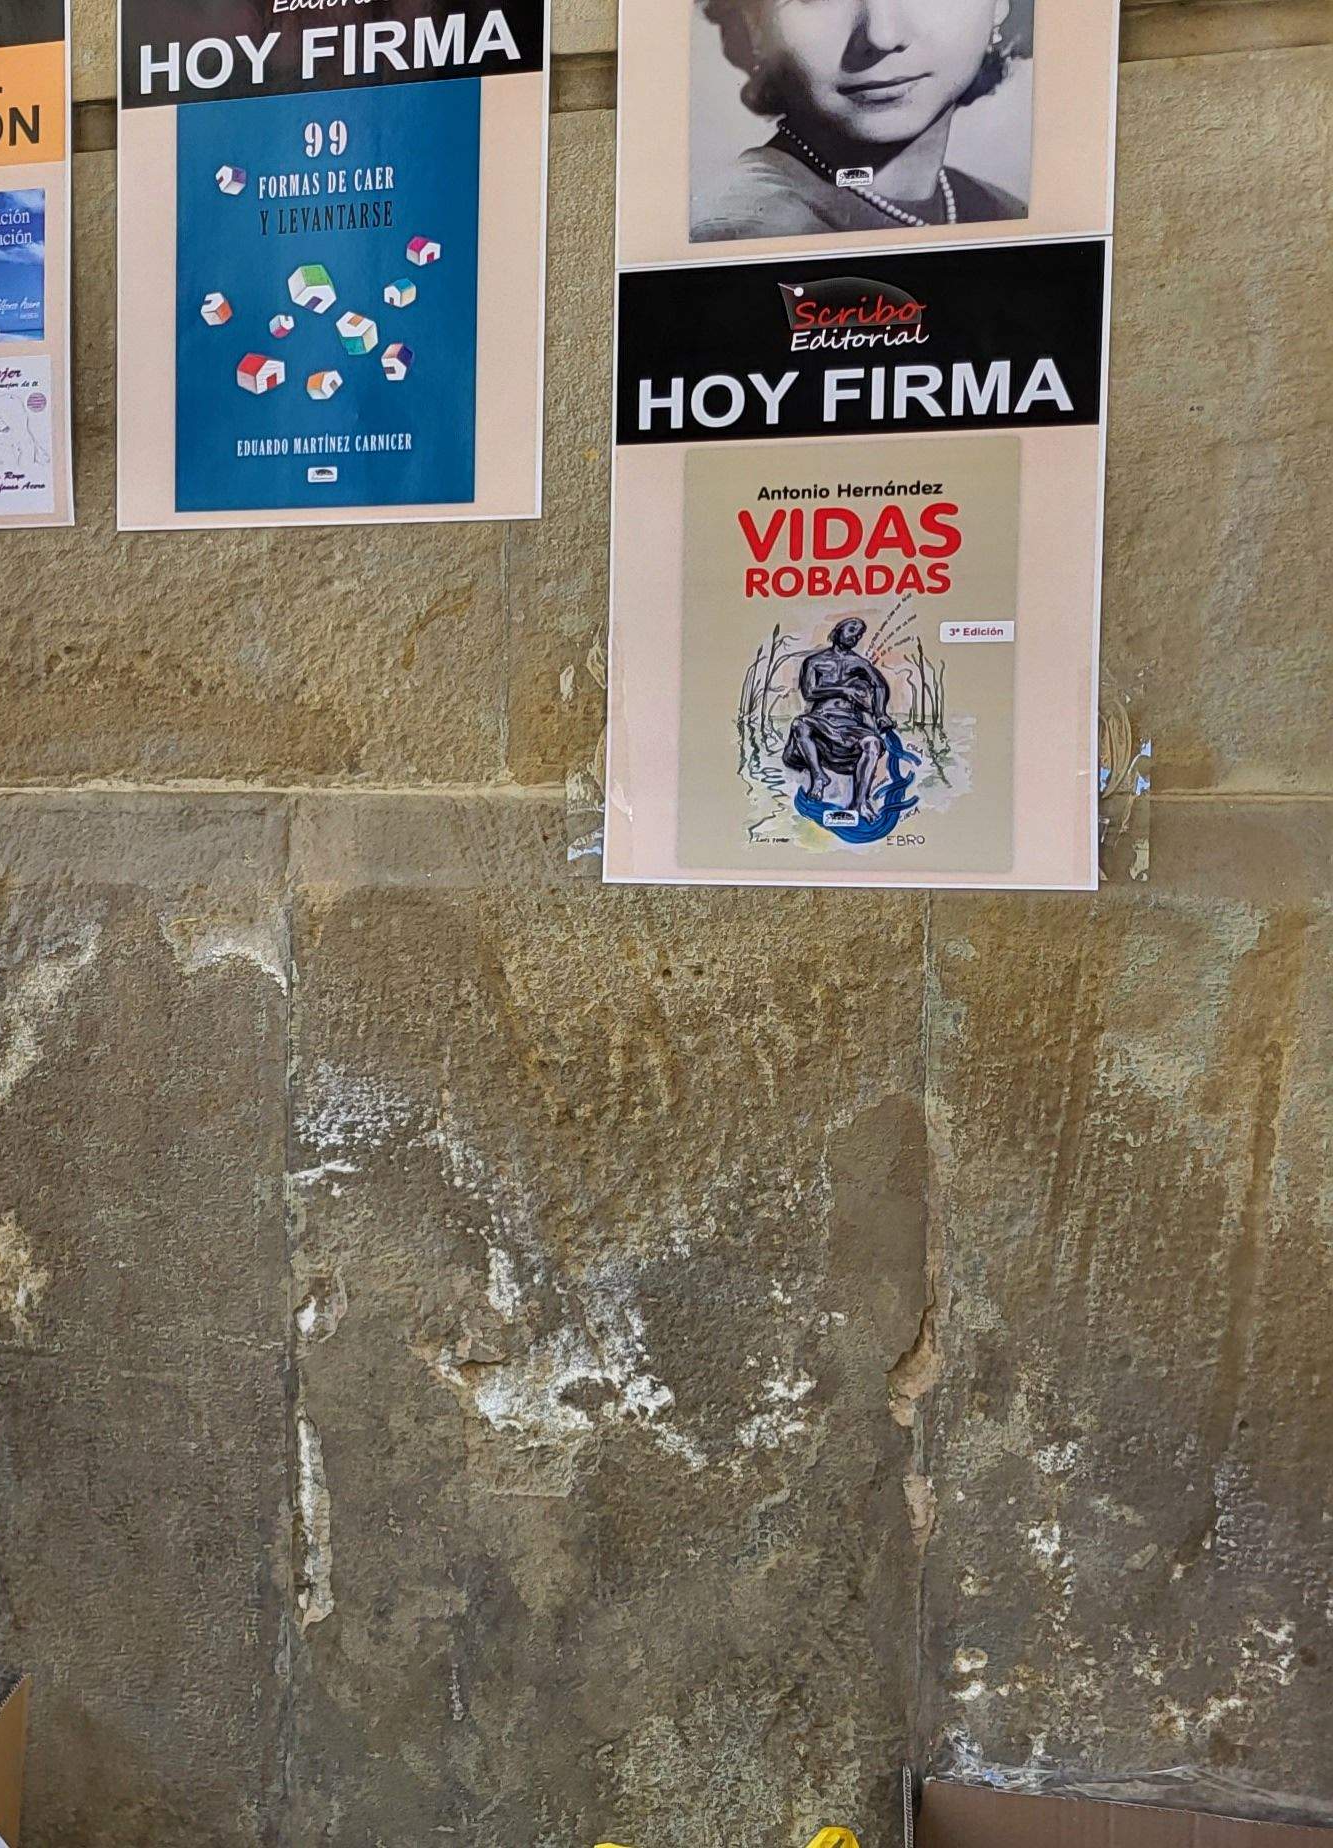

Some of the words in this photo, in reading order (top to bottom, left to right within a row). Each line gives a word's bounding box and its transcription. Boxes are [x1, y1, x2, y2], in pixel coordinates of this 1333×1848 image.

[139, 31, 280, 95] HOY
[301, 10, 521, 80] FIRMA
[304, 120, 348, 158] 99
[258, 171, 320, 199] FORMAS
[327, 169, 348, 193] DE
[354, 166, 395, 191] CAER
[259, 210, 269, 236] Y
[277, 200, 393, 235] LEVANTARSE
[794, 297, 927, 329] Scribo
[791, 324, 929, 352] Editorial
[638, 371, 798, 431] HOY
[823, 358, 1075, 422] FIRMA
[237, 438, 289, 457] EDUARDO
[293, 432, 351, 455] MARTÍNEZ
[355, 433, 412, 453] CARNICER
[757, 482, 831, 502] Antonio
[836, 478, 944, 499] Hernández
[737, 502, 962, 563] VIDAS
[744, 562, 953, 599] ROBADAS
[963, 626, 1004, 636] Edición
[886, 835, 925, 847] EBRO
